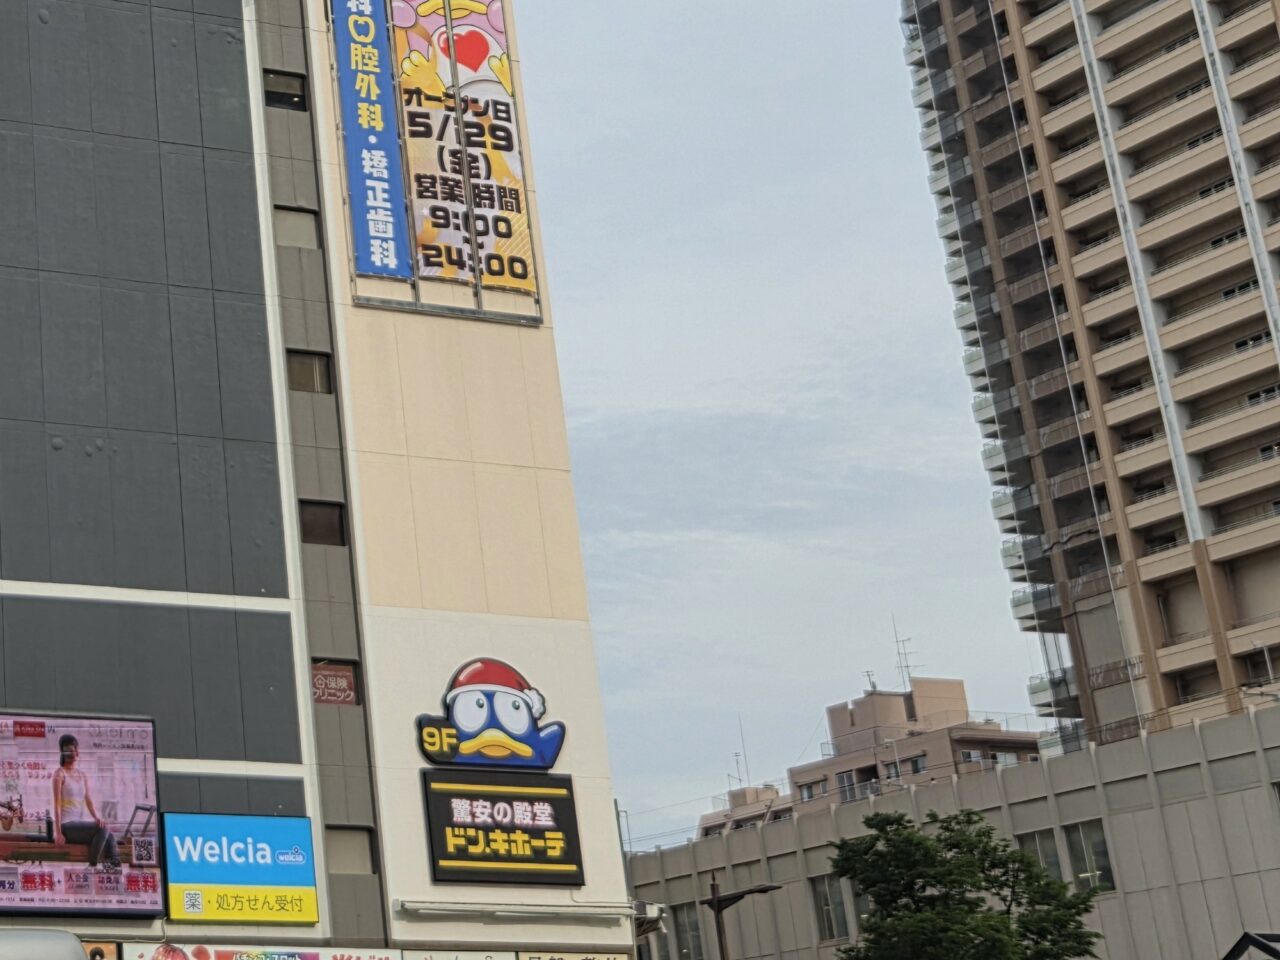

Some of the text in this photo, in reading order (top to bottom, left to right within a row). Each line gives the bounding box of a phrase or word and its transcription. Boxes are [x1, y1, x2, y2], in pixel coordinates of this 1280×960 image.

[422, 727, 458, 753] 9F
[451, 797, 557, 828] 驚安の殿堂
[173, 836, 304, 864] Welcia welcia
